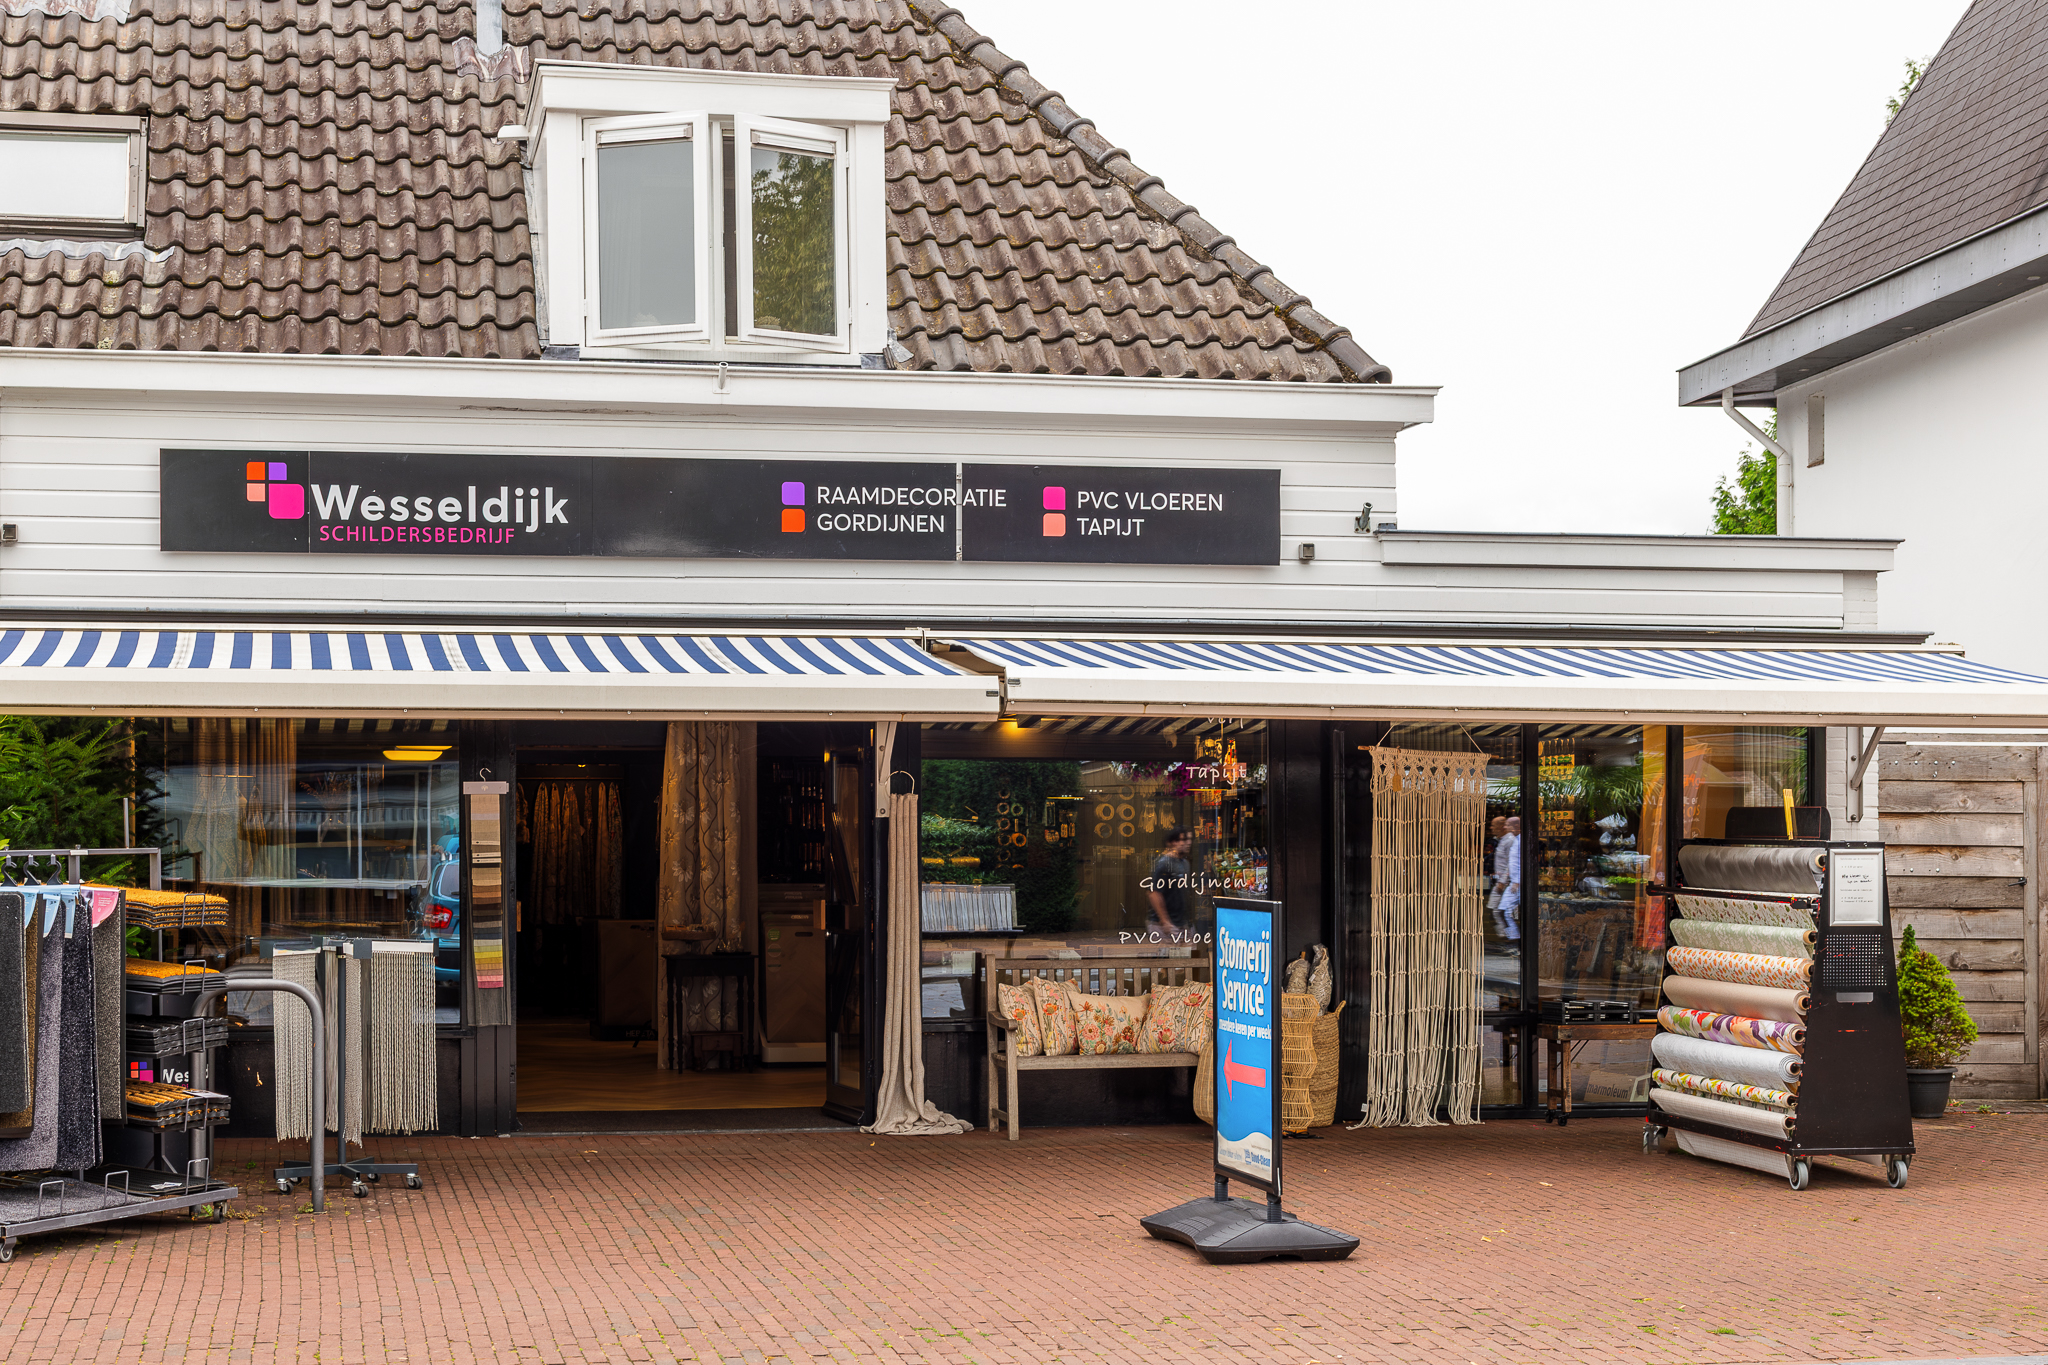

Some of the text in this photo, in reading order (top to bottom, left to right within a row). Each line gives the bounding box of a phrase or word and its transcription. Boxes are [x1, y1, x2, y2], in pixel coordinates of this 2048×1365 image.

[817, 487, 1006, 508] RAAMDECORATIE
[1077, 491, 1223, 512] PVC VLOEREN
[311, 484, 568, 533] Wesseldijk
[817, 513, 945, 533] GORDIJNEN
[1077, 518, 1145, 537] TAPIJT
[319, 525, 515, 544] SCHILDERSBEDRIJF
[1186, 762, 1247, 785] Tapijt
[1139, 872, 1248, 895] Gordijnen
[1119, 929, 1212, 944] PVC vloe
[1219, 926, 1270, 985] Stomerij
[1222, 969, 1265, 1016] Service
[1247, 1025, 1256, 1040] per
[1256, 1024, 1271, 1040] week
[1586, 1083, 1629, 1099] marmoleum
